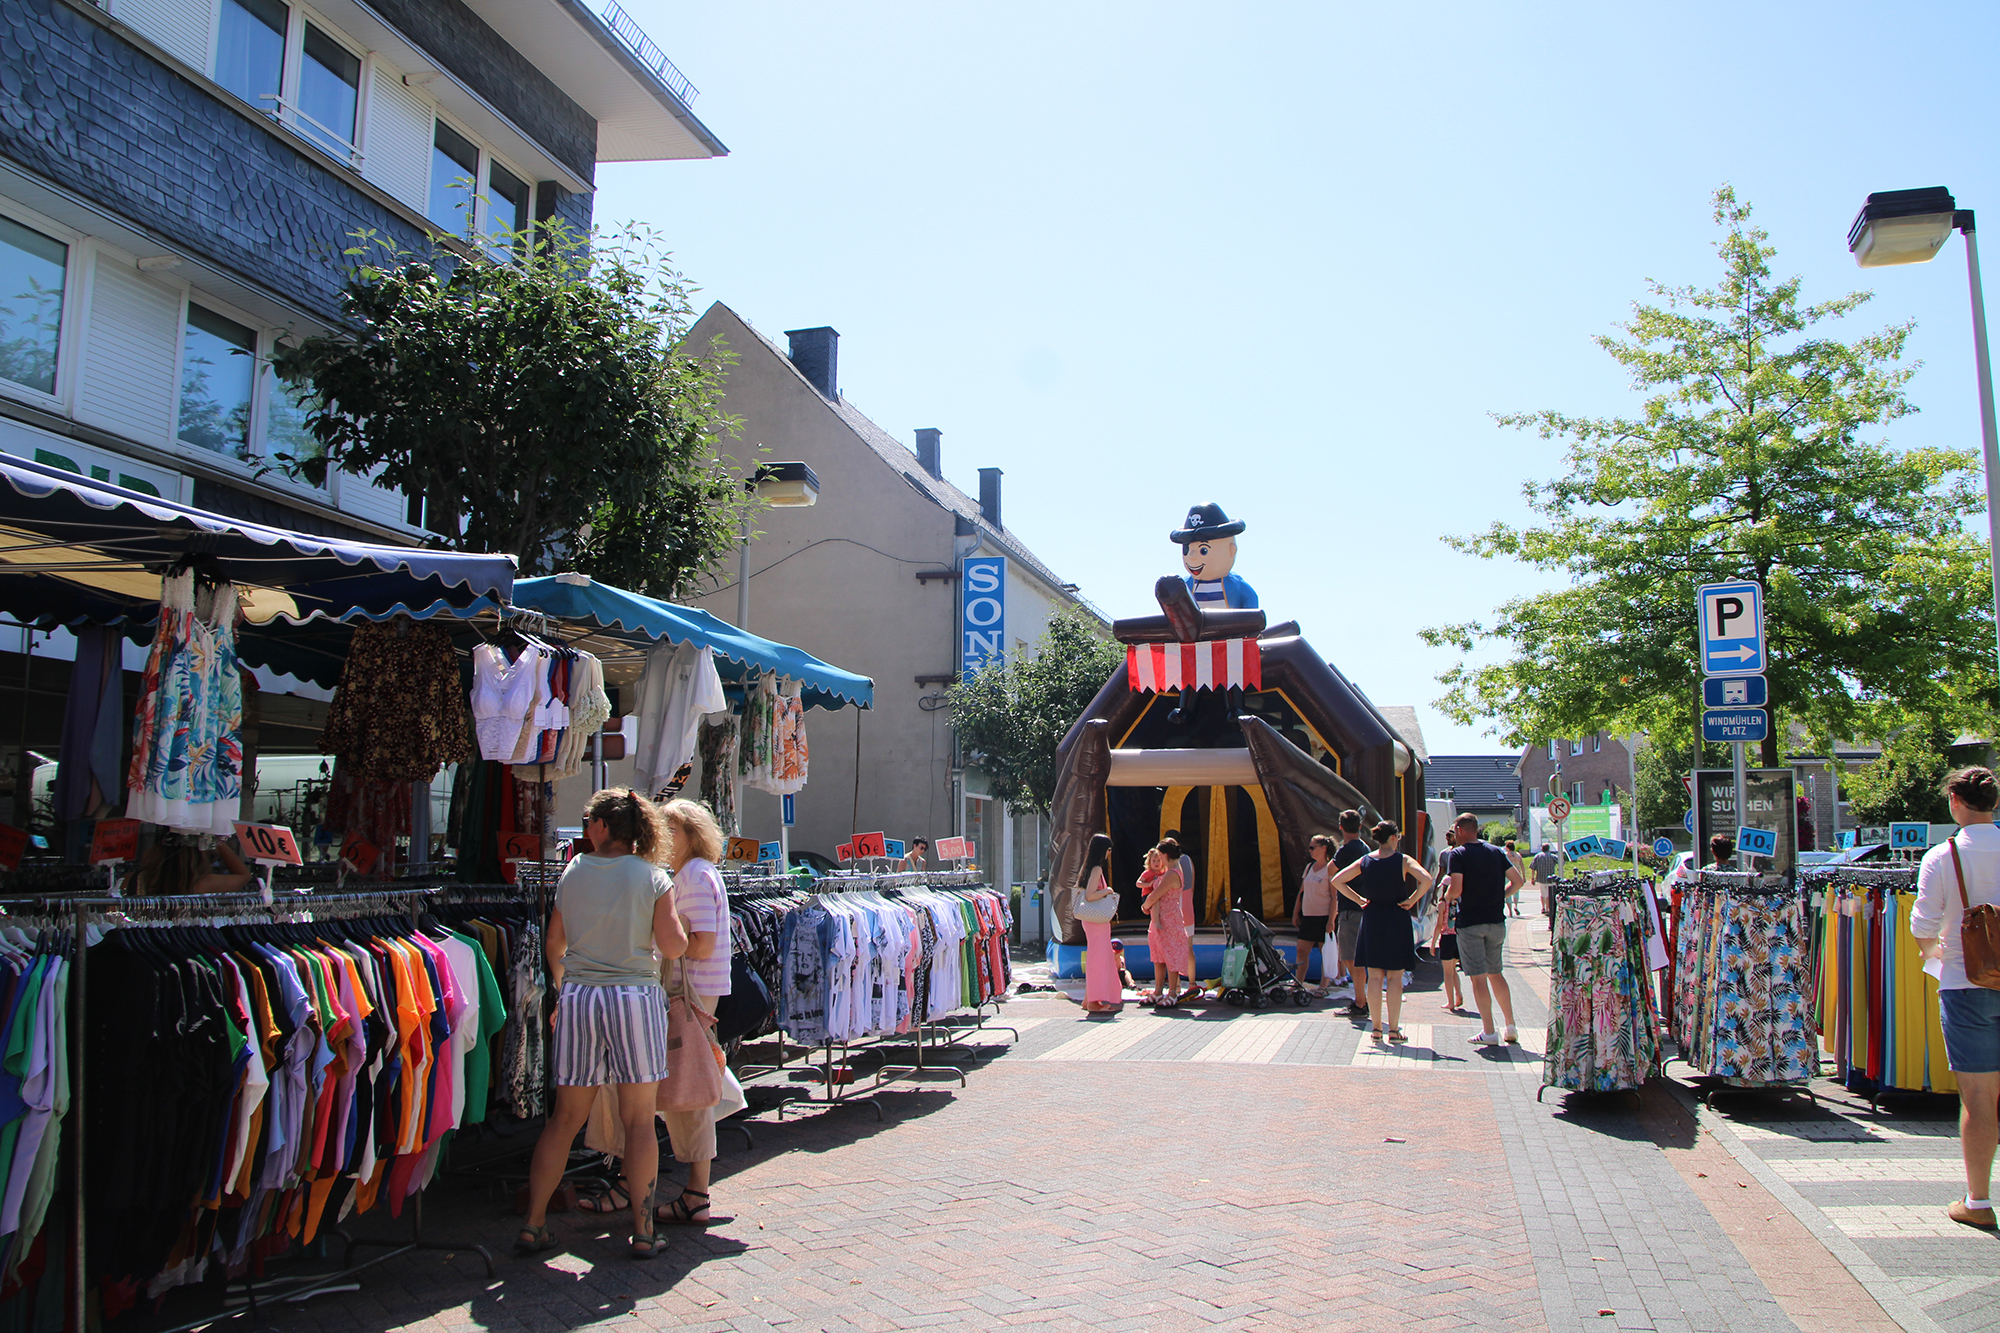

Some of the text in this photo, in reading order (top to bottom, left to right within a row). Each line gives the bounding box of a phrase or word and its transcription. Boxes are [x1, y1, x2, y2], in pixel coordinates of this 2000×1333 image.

[1716, 597, 1744, 636] P
[1707, 714, 1762, 726] WINDMÜHLEN
[1722, 726, 1747, 736] PLATZ
[942, 844, 962, 857] 5,00
